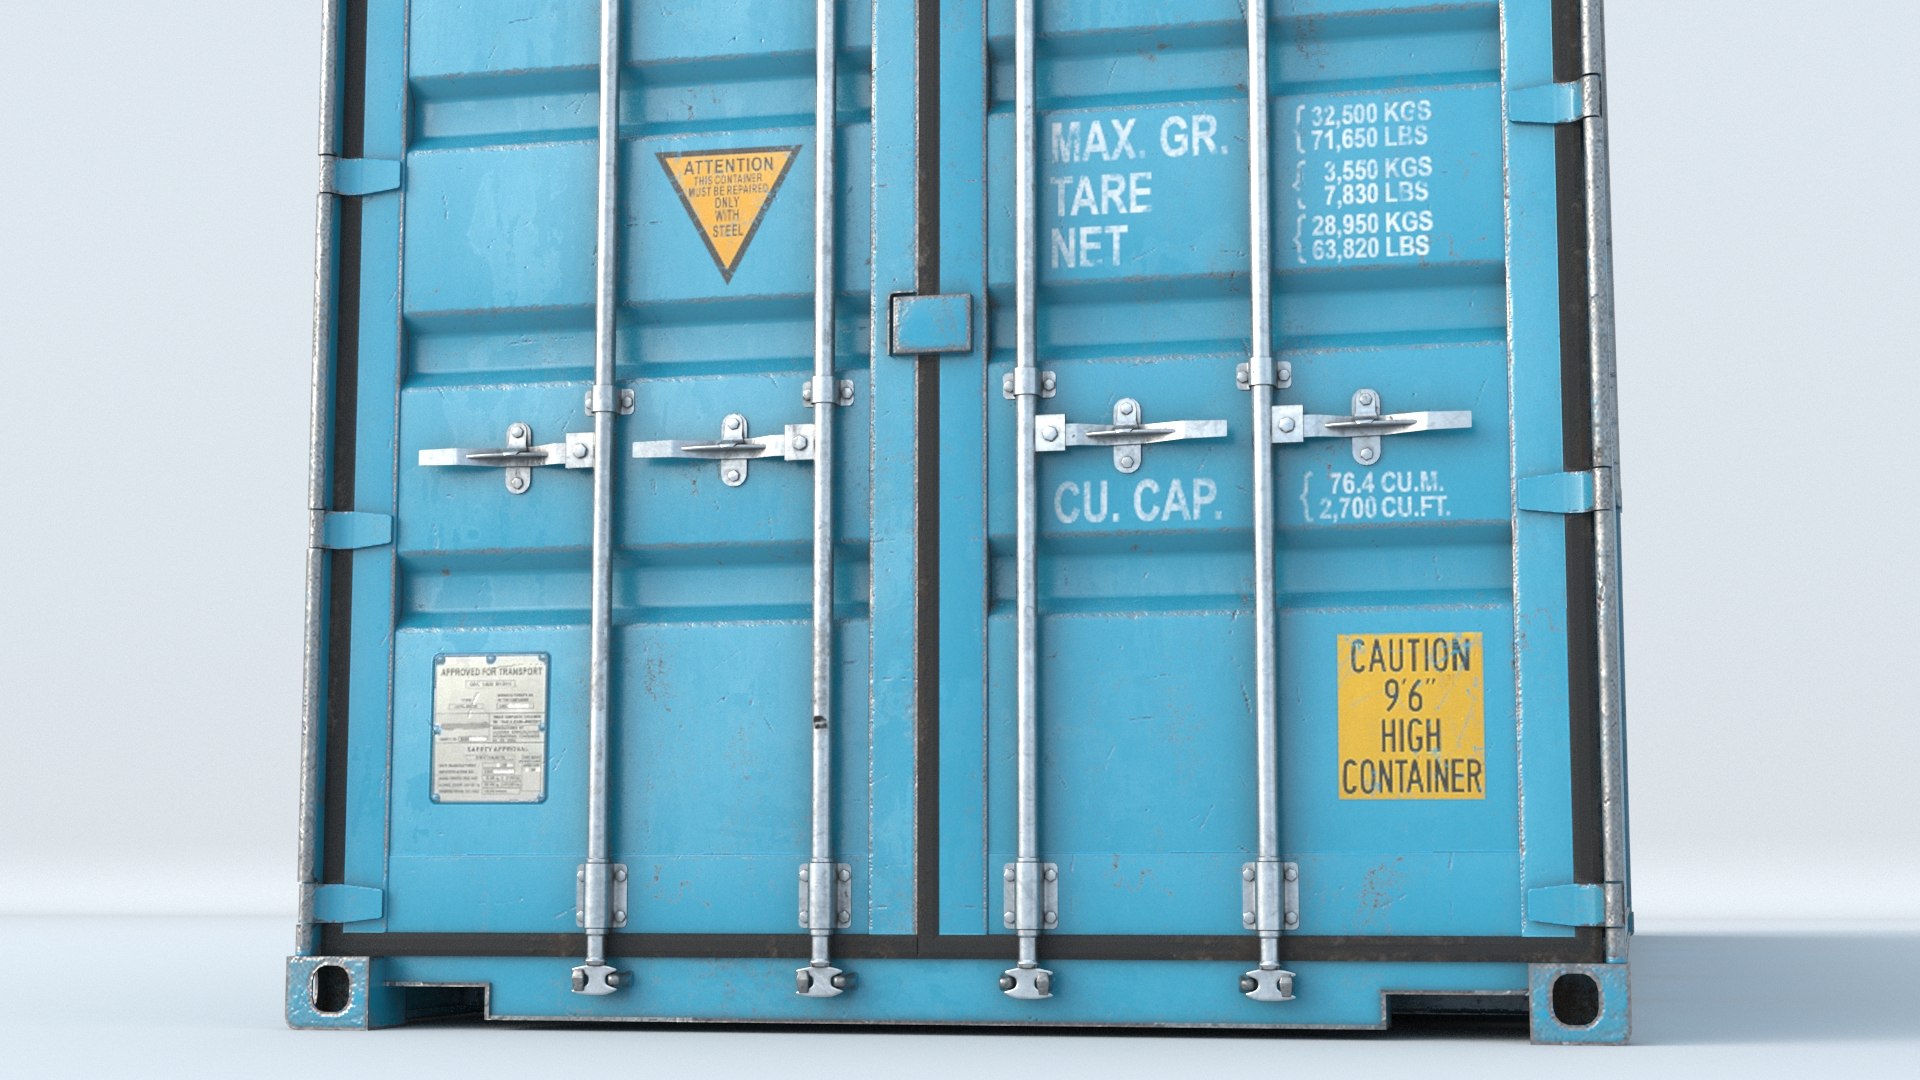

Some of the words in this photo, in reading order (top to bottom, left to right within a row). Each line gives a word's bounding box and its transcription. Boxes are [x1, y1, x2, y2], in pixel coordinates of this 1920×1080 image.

[1311, 103, 1378, 128] 32,500
[1384, 100, 1432, 122] KGS
[1050, 117, 1146, 163] MAX.
[1160, 114, 1229, 157] GR.
[1311, 129, 1378, 152] 71,650
[1384, 125, 1428, 147] LBS
[684, 157, 774, 175] ATTENTION
[694, 175, 712, 186] THIS
[714, 173, 762, 185] CONTAINER
[1324, 159, 1378, 183] 3,550
[1384, 156, 1433, 177] KGS
[688, 187, 712, 197] MUST
[713, 186, 724, 196] BE
[727, 184, 769, 195] REPAIRED
[715, 196, 740, 208] ONLY
[1050, 172, 1152, 217] TARE
[1324, 184, 1378, 208] 7,830
[1384, 181, 1429, 203] LBS
[715, 209, 739, 222] WITH
[1311, 213, 1379, 237] 28,950
[1385, 210, 1434, 232] KGS
[713, 223, 744, 237] STEEL
[1050, 225, 1128, 269] NET
[1311, 237, 1379, 261] 63,820
[1385, 235, 1430, 257] LBS
[1330, 472, 1375, 495] 76.4
[1380, 470, 1445, 492] CU.M.
[1053, 480, 1120, 524] CU.
[1133, 478, 1223, 522] CAP.
[1319, 496, 1376, 520] 2,700
[1381, 494, 1451, 518] CU.FT.
[1350, 637, 1471, 673] CAUTION
[441, 667, 481, 677] APPROVED
[482, 667, 497, 676] FOR
[499, 666, 543, 676] TRANSPORT
[1381, 718, 1441, 753] HIGH
[1342, 758, 1482, 794] CONTAINER
